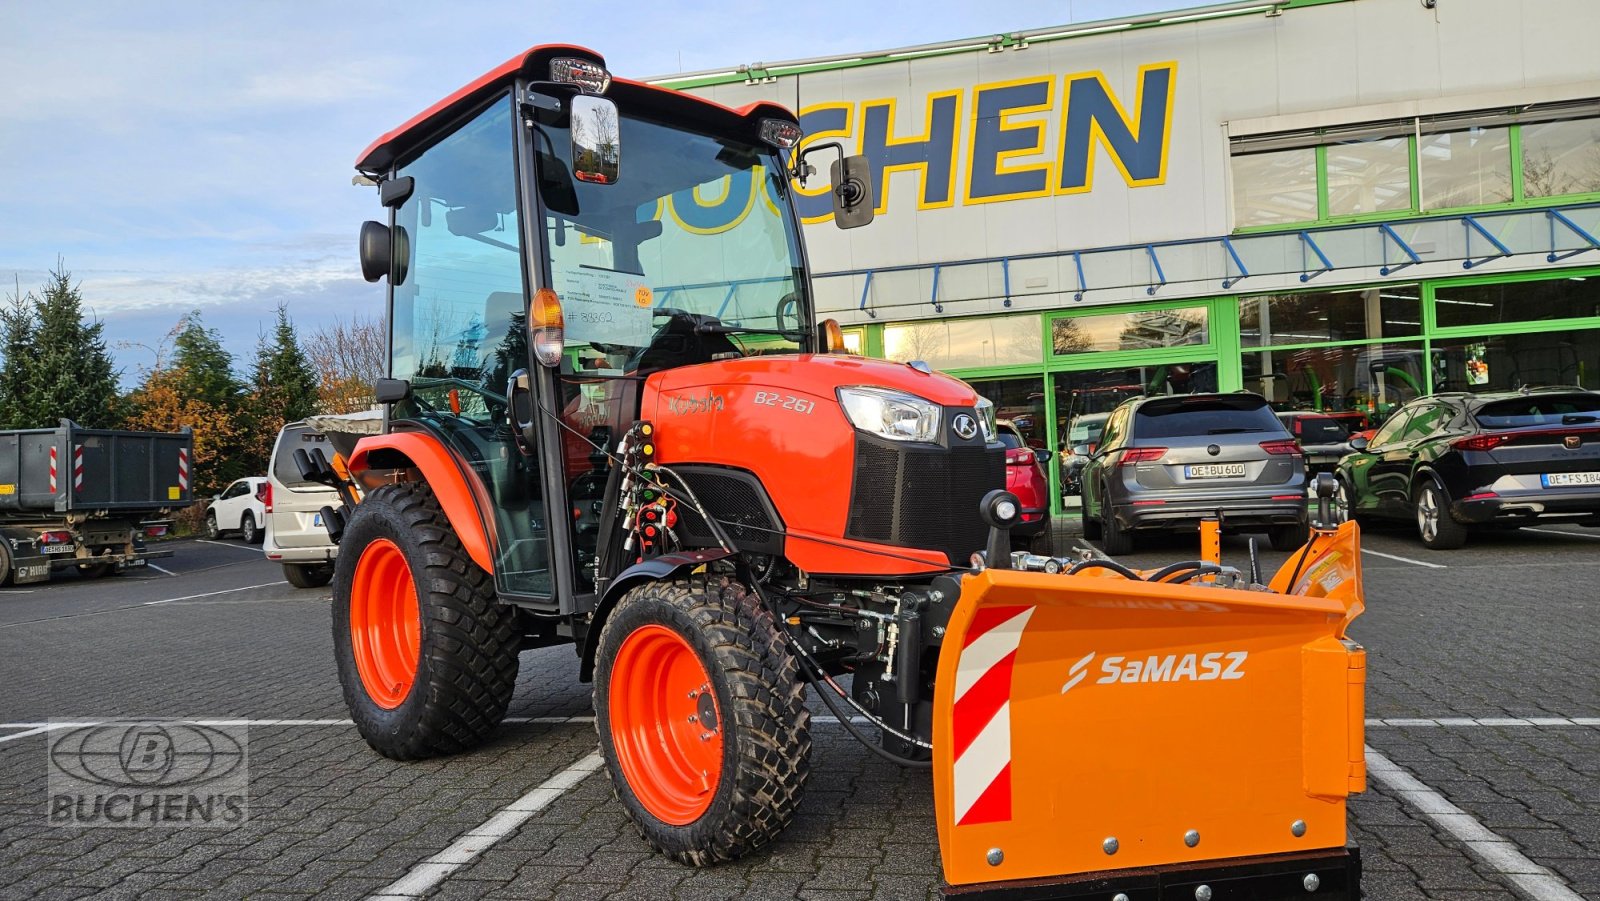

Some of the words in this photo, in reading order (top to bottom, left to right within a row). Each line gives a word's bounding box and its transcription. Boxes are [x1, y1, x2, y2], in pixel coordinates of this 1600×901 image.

[580, 61, 1178, 243] CHEN
[753, 391, 815, 415] B2-261
[1096, 651, 1249, 684] SaMASZ
